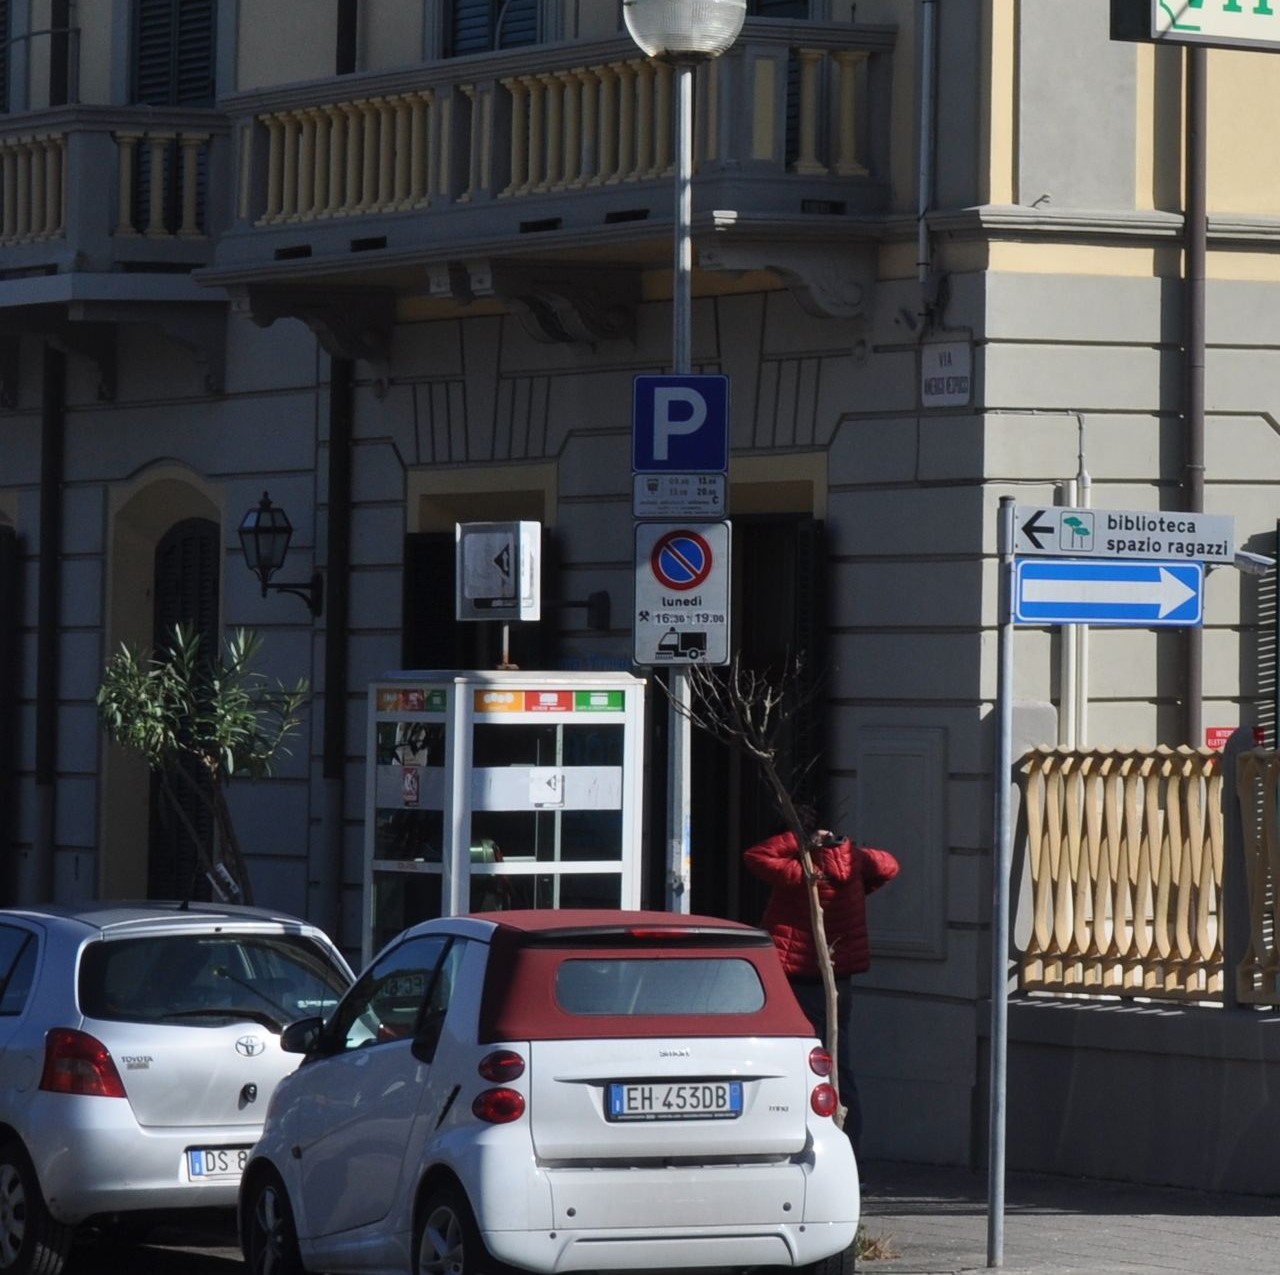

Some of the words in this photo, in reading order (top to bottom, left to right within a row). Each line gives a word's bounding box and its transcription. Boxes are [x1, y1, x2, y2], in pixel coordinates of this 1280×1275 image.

[938, 351, 952, 367] VIA
[653, 386, 708, 461] P
[1107, 514, 1197, 533] biblioteca
[1106, 537, 1162, 555] spazio
[1168, 540, 1228, 557] ragazzi
[695, 613, 724, 624] 19.00
[121, 1055, 154, 1063] TOYOTA
[627, 1086, 653, 1110] EH
[662, 1086, 727, 1110] 453DB
[205, 1150, 228, 1172] DS
